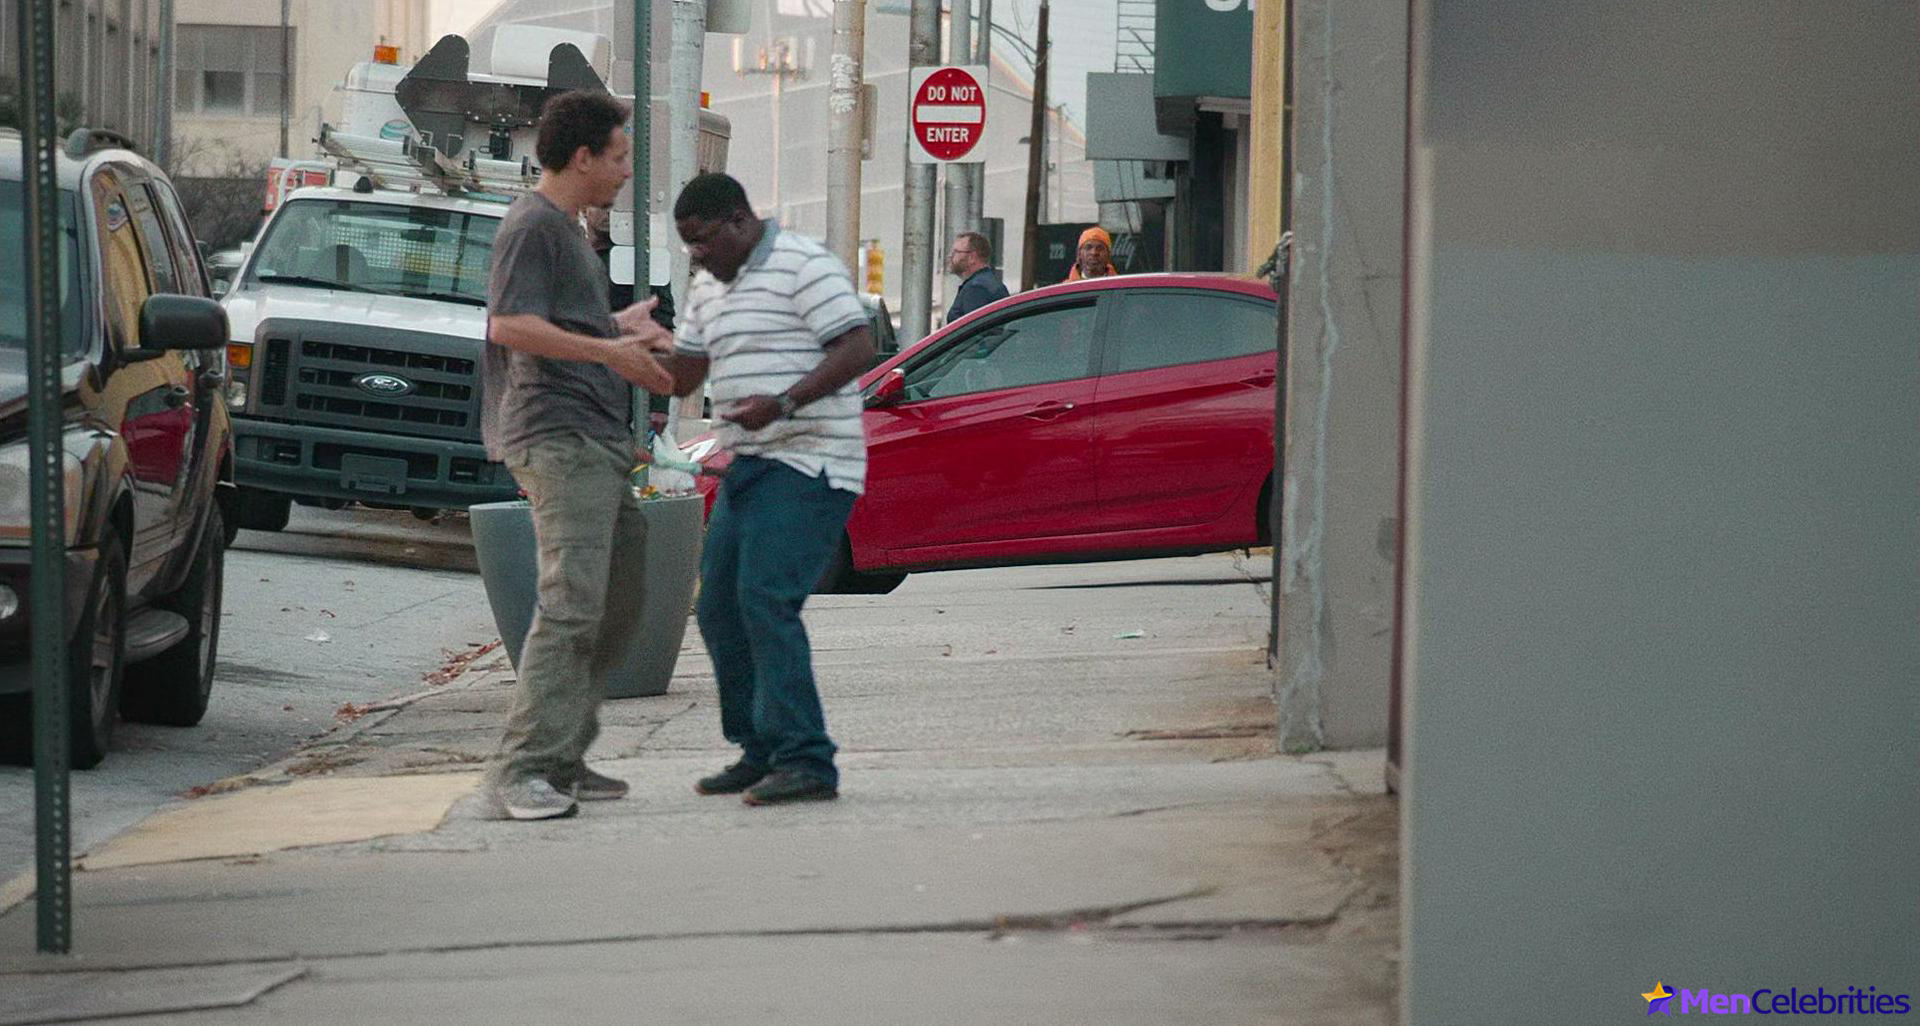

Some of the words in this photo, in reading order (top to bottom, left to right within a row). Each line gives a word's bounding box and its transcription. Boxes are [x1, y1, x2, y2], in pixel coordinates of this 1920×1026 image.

[927, 86, 946, 101] DO
[951, 86, 977, 101] NOT
[927, 127, 969, 143] ENTER
